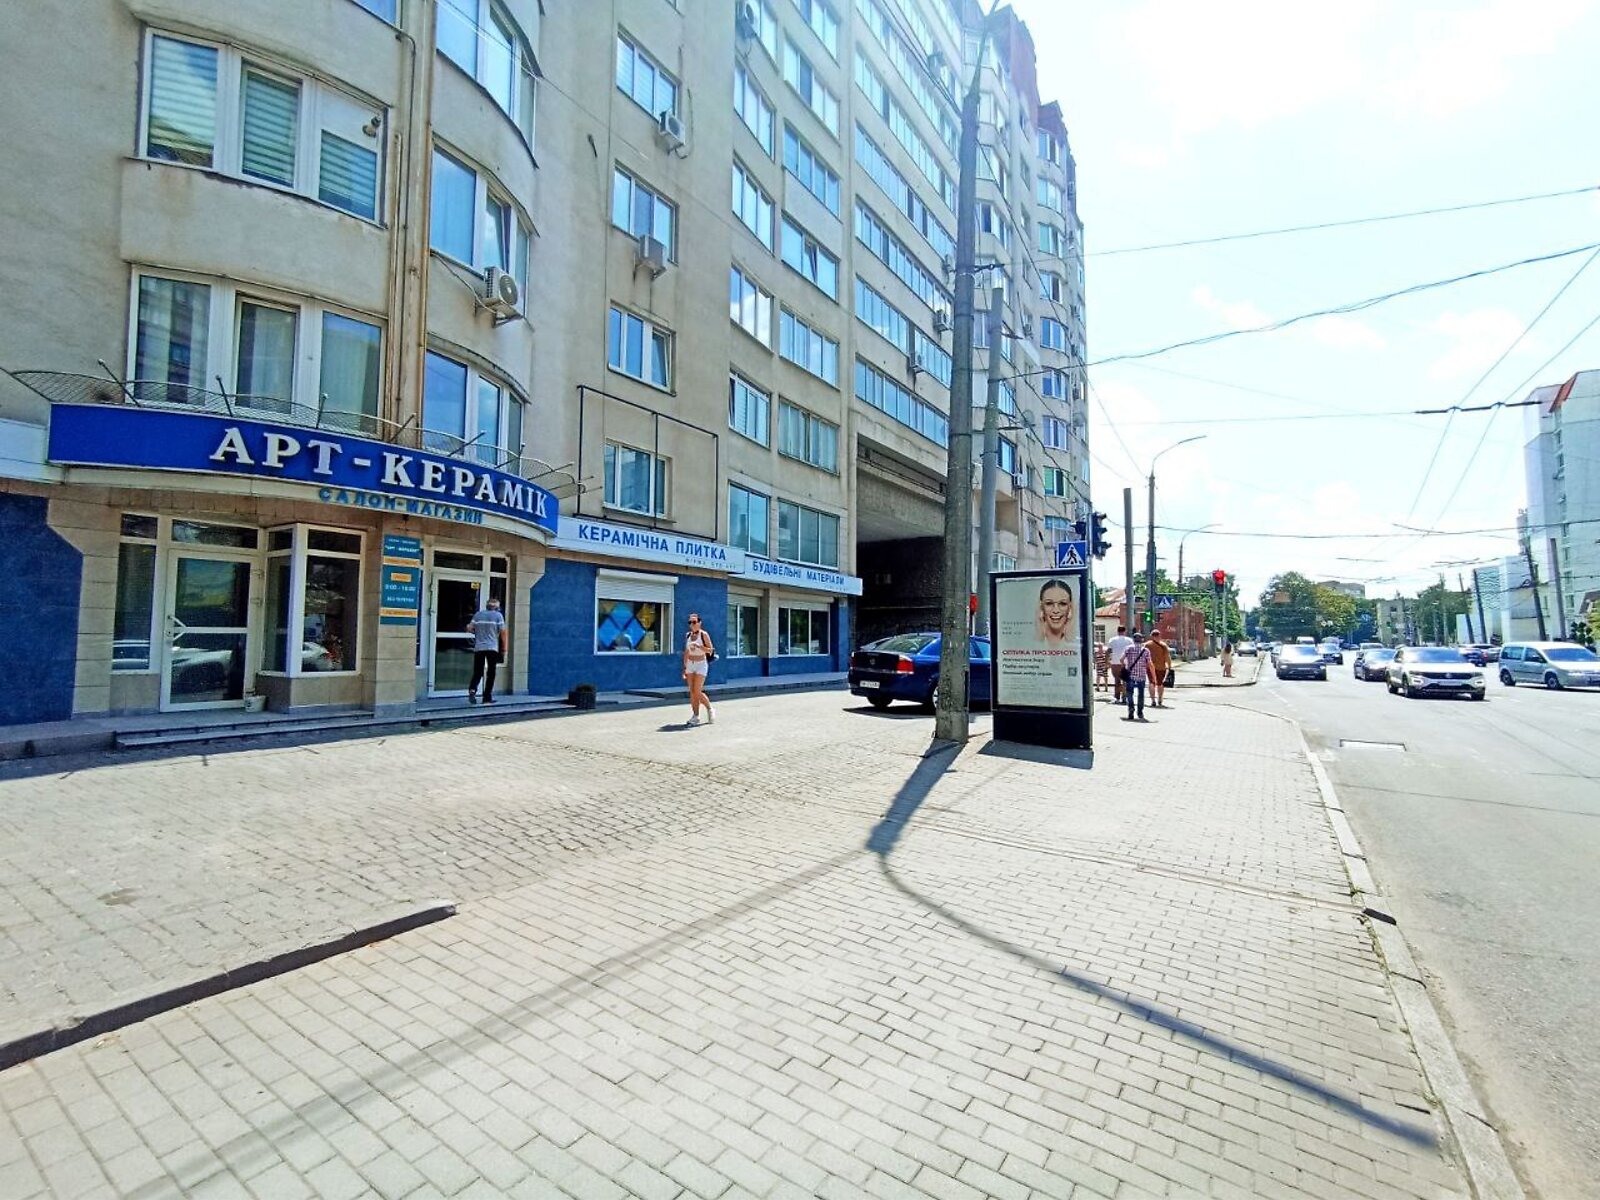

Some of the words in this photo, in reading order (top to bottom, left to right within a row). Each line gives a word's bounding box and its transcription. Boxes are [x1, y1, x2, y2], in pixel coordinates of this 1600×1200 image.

[578, 524, 670, 552] КЕРАМІЧНА
[676, 541, 727, 561] ПЛИТКА
[752, 560, 802, 580] БУДІВЕЛЬНІ
[806, 571, 846, 586] МАТЕРІАЛИ
